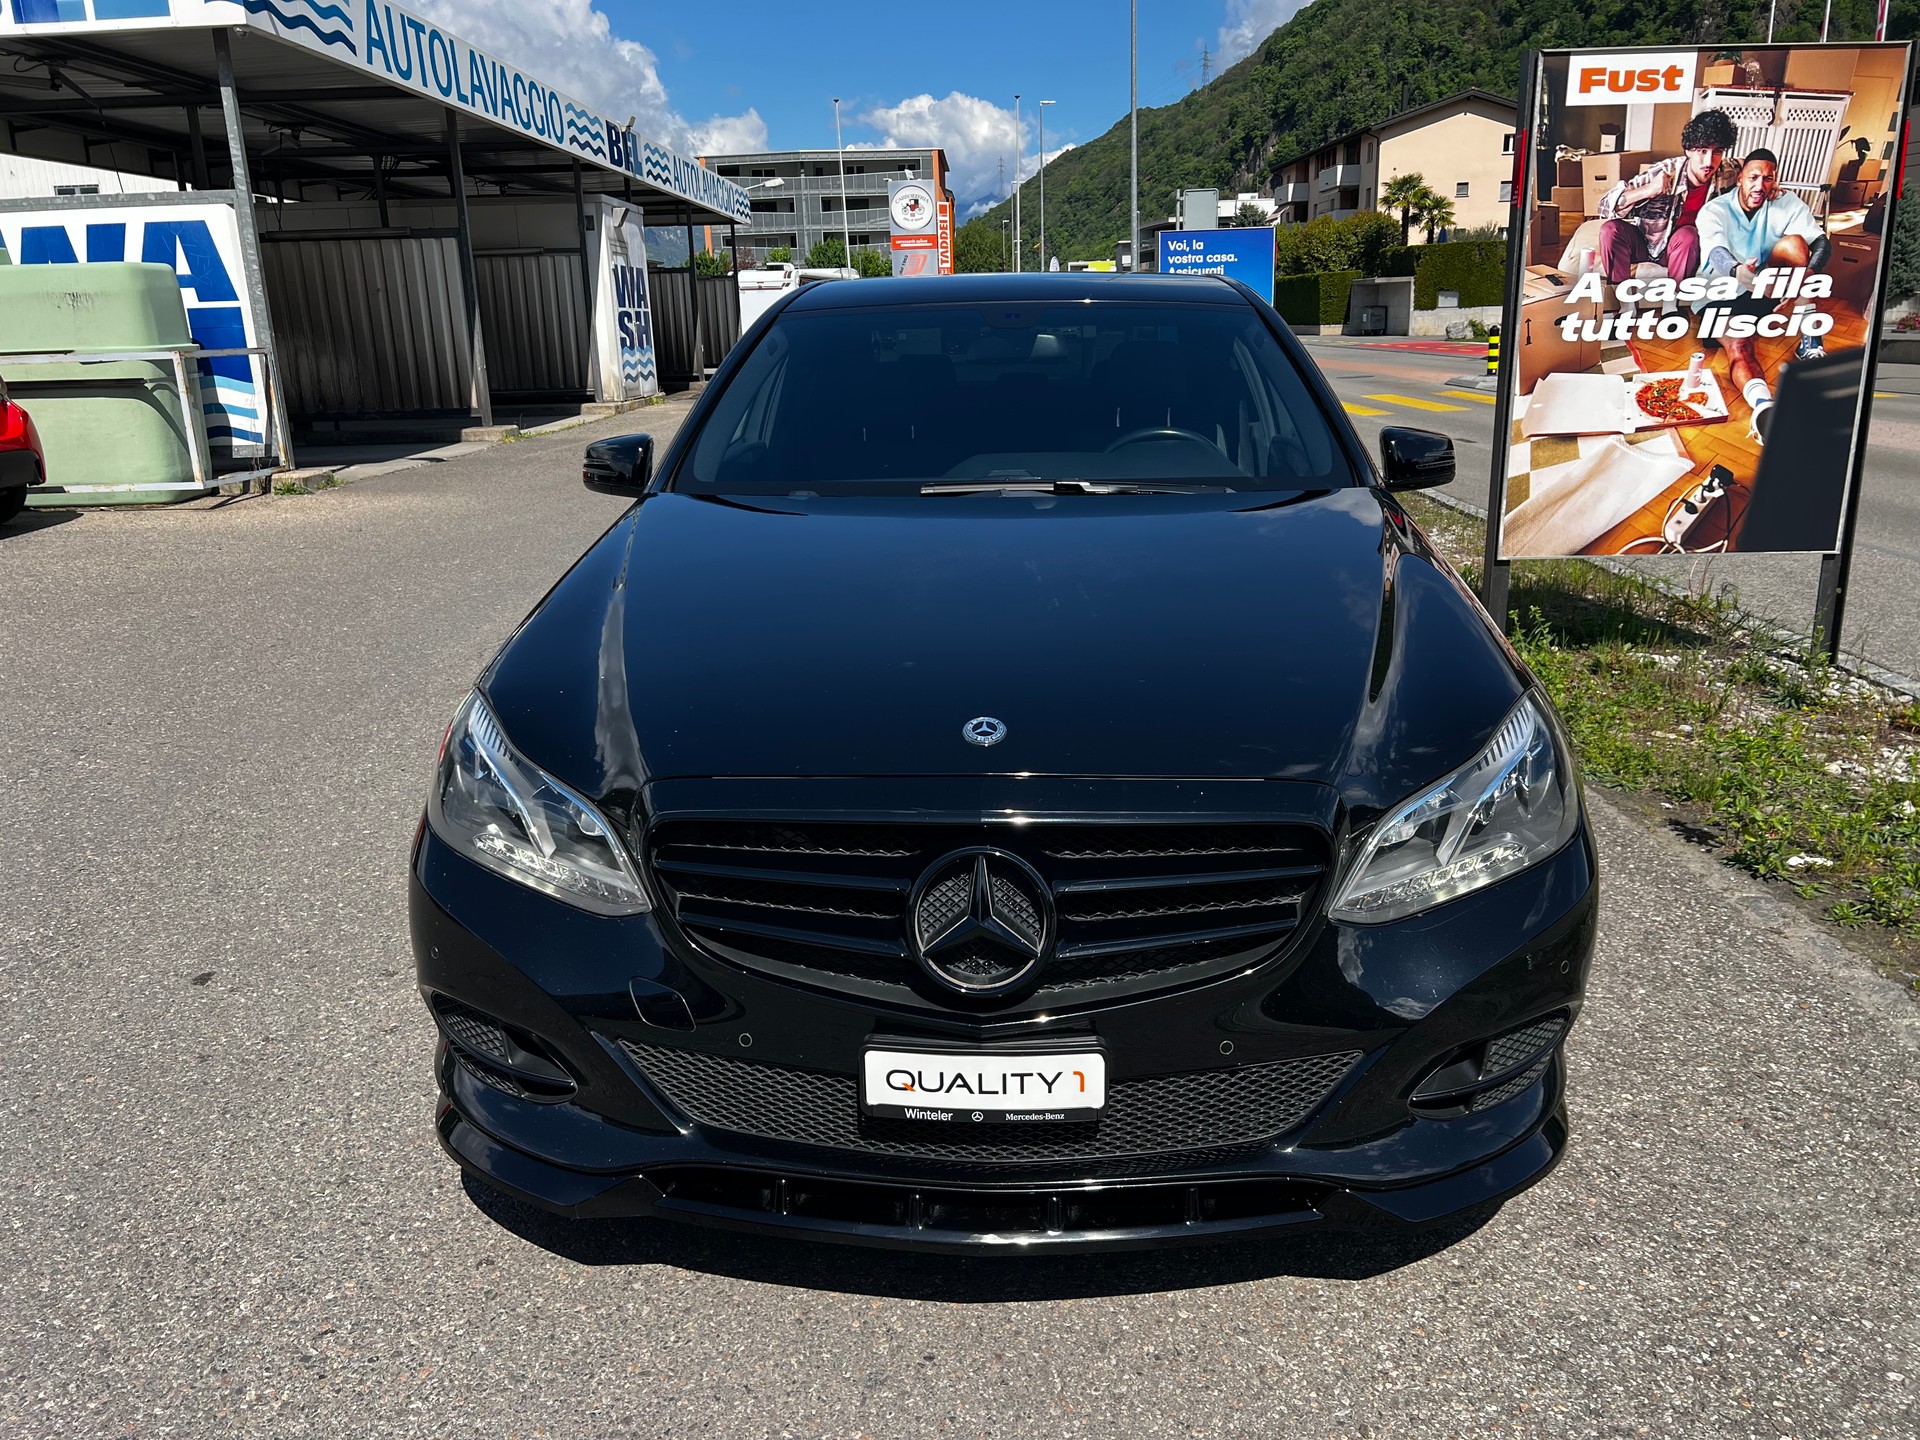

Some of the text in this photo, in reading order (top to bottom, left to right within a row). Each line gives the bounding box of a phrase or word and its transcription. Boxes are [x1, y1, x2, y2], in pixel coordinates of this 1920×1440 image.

[366, 0, 564, 144] AUTOLAVACCIO
[1578, 64, 1684, 94] Fust
[606, 120, 643, 176] BEL
[673, 155, 736, 215] AUTOLAVACCIO
[939, 219, 948, 265] TADDEI
[1168, 239, 1204, 252] Voi, la
[1168, 253, 1238, 263] vostra casa.
[1564, 266, 1832, 304] A casa fila
[1559, 304, 1834, 342] tutto liscio
[885, 1069, 1085, 1095] QUALITY 1
[904, 1108, 953, 1122] Winteler
[1005, 1112, 1065, 1121] Mercedes-Benz
